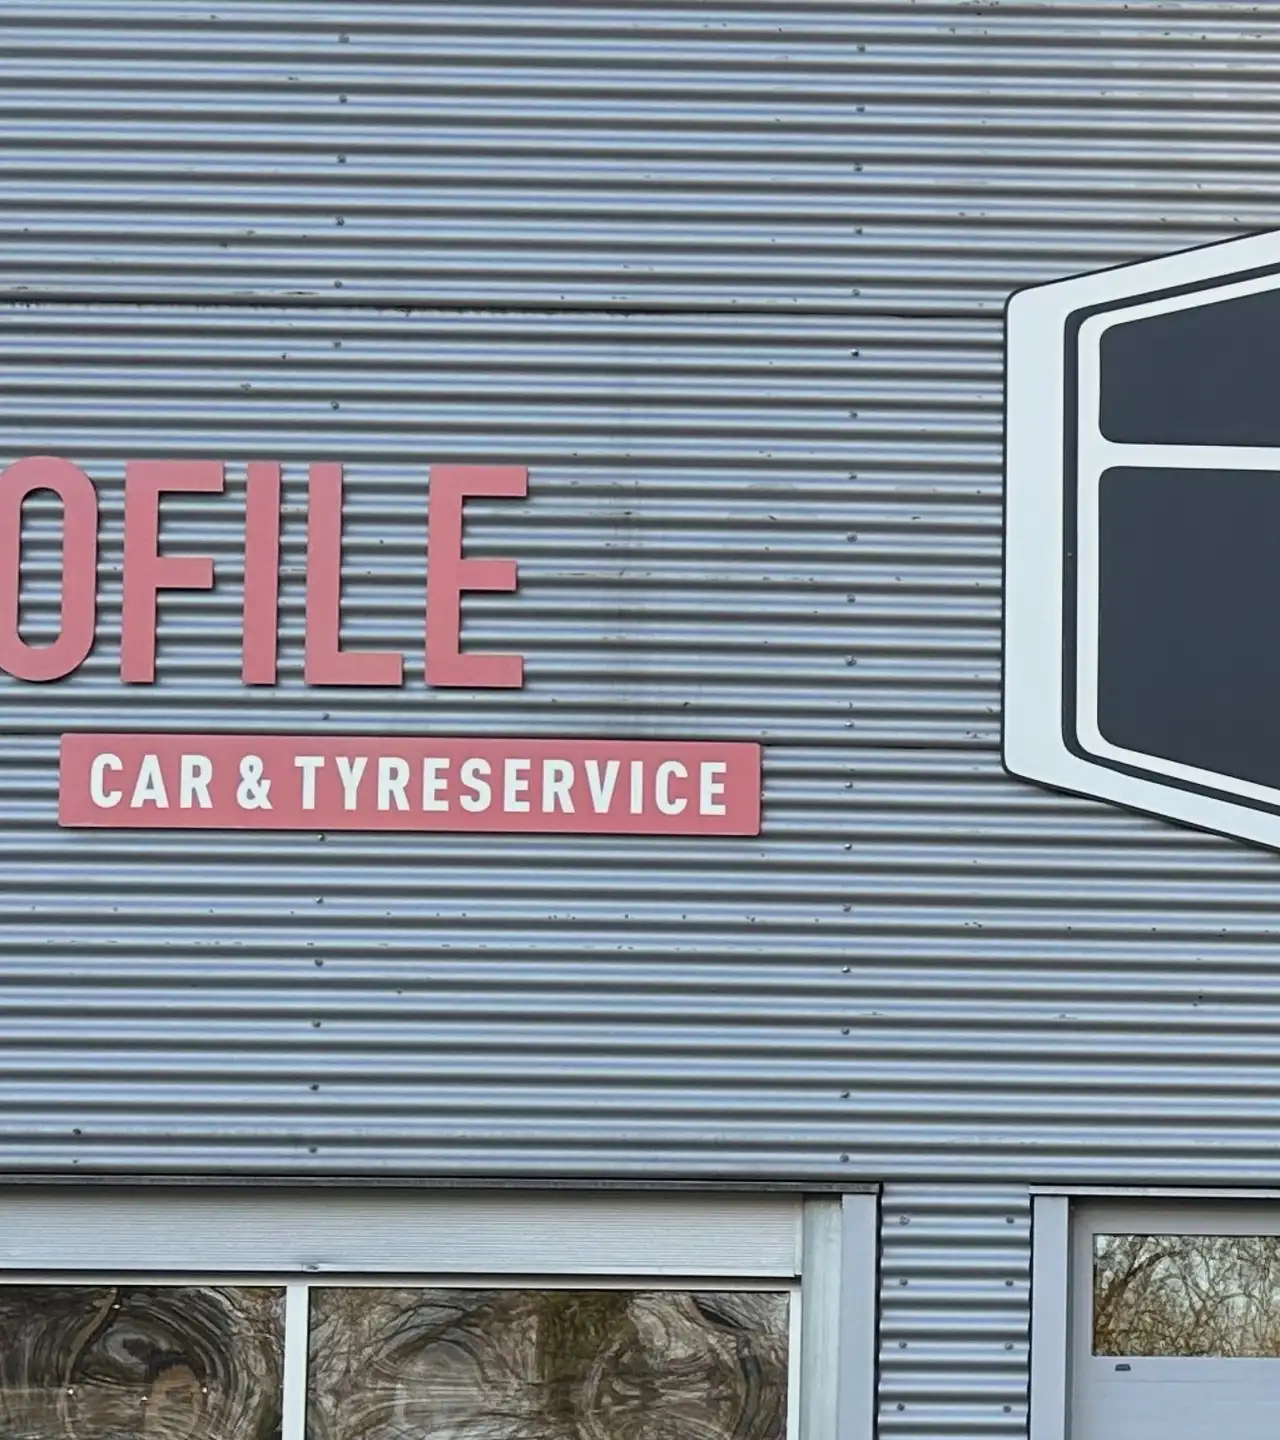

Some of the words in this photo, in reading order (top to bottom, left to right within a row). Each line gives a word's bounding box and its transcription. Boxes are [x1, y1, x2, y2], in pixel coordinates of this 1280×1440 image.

[0, 455, 529, 689] OFILE
[90, 753, 214, 809] CAR
[236, 754, 273, 810] &
[294, 755, 728, 816] TYRESERVICE
